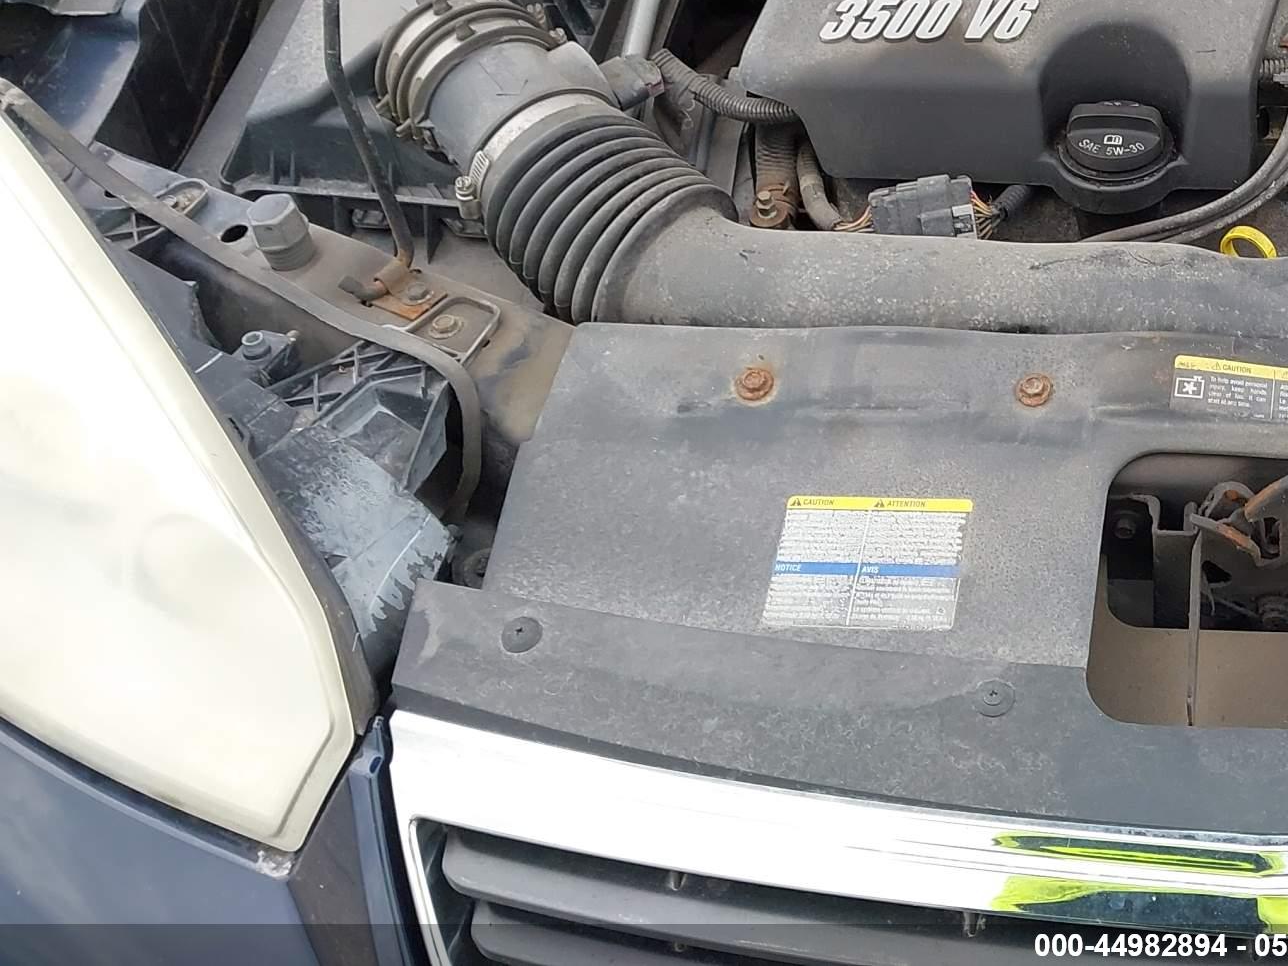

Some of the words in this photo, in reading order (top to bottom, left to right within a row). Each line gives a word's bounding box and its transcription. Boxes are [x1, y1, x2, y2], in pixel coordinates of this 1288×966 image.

[1078, 139, 1101, 154] SAE
[1106, 142, 1145, 155] 5W-30
[1222, 364, 1252, 374] CAUTION
[887, 500, 926, 508] ATTENTION
[775, 564, 801, 572] NOTICE
[862, 566, 879, 574] AVIS
